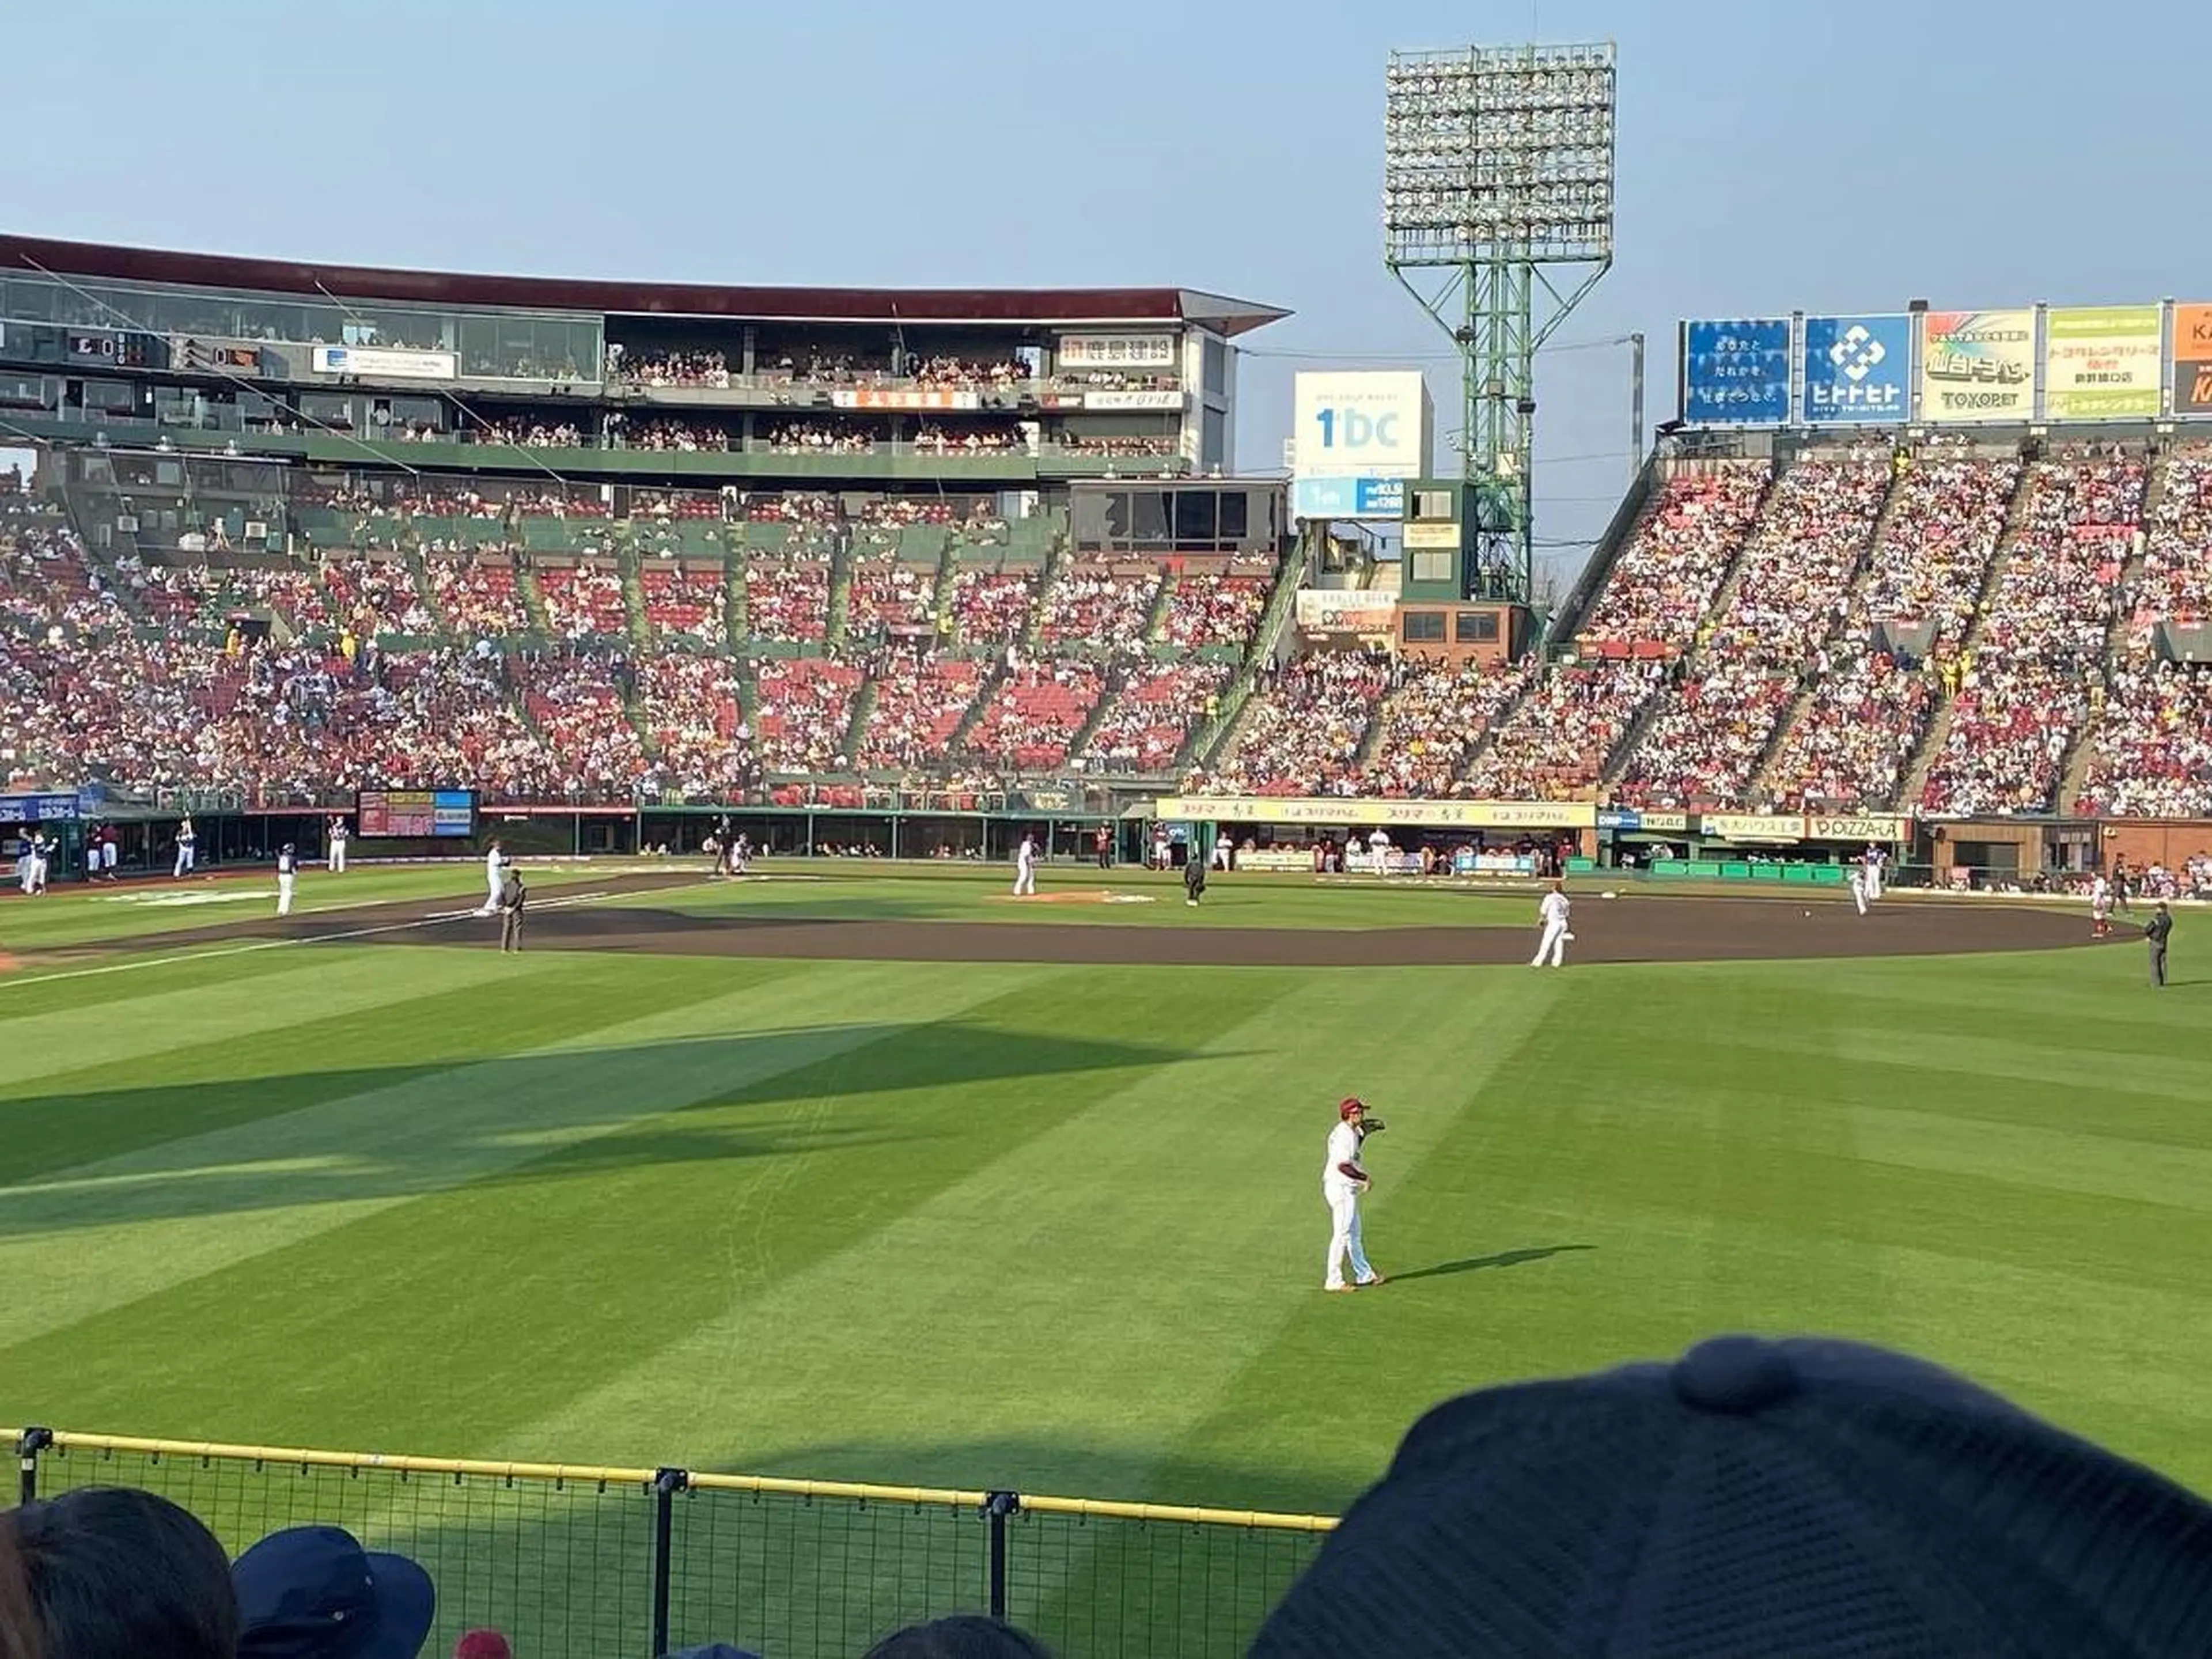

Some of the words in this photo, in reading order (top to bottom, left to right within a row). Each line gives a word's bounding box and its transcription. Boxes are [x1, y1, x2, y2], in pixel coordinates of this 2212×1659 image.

[1813, 383, 1900, 404] ヒトトヒト
[1941, 392, 2018, 408] TOYOPET
